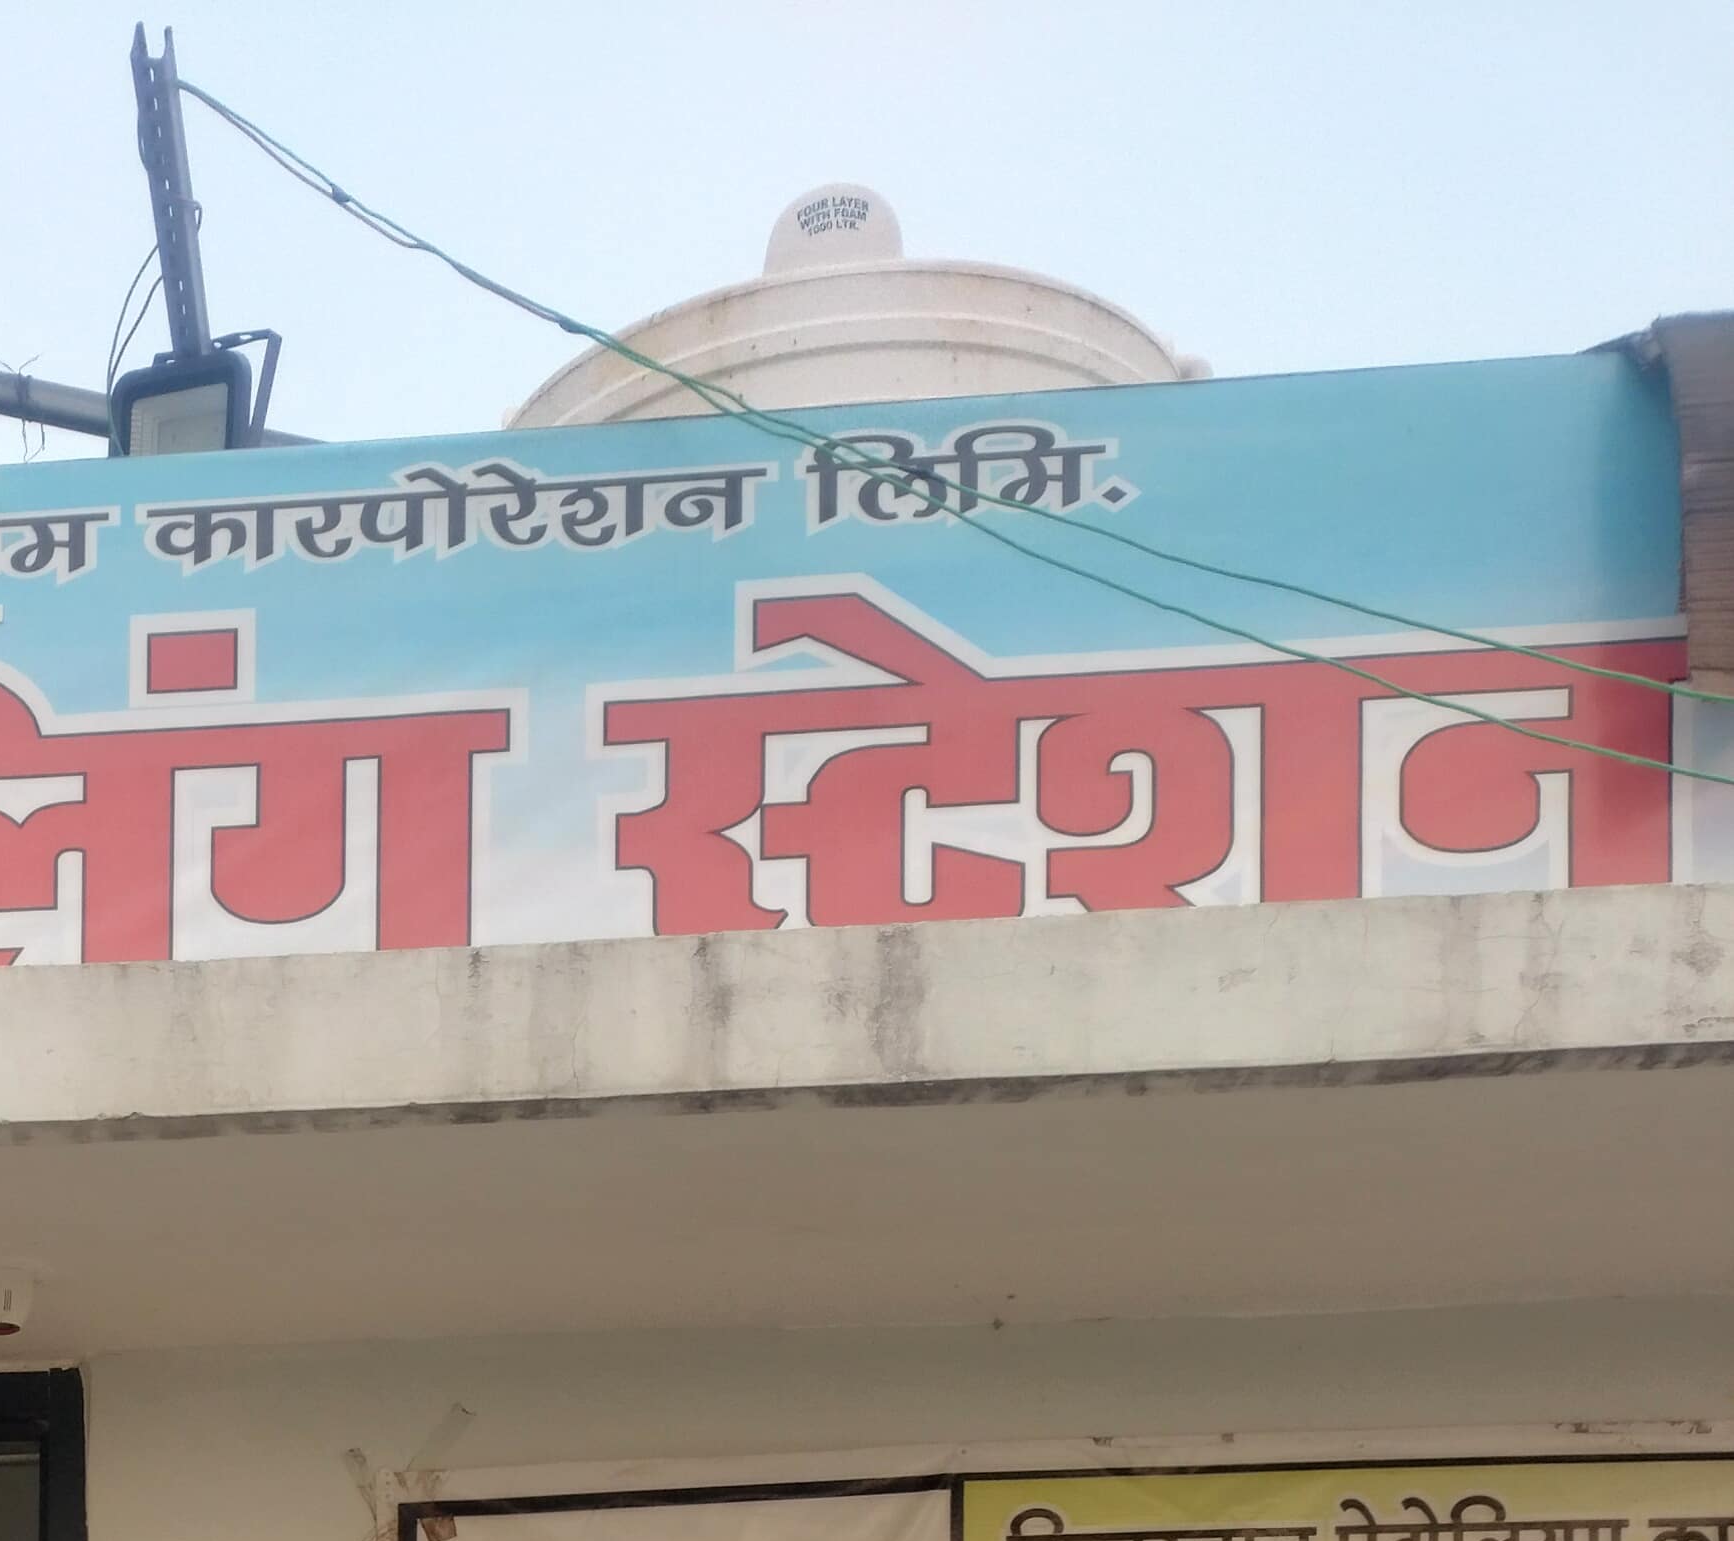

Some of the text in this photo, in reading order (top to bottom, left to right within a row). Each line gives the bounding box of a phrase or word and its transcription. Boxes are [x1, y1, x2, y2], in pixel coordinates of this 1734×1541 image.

[797, 196, 868, 220] FOUR LAYER
[800, 208, 866, 230] WITH FOAM
[147, 462, 765, 562] कारपोरेशन
[809, 424, 1128, 522] लिमि.
[604, 592, 1688, 936] स्टेशन
